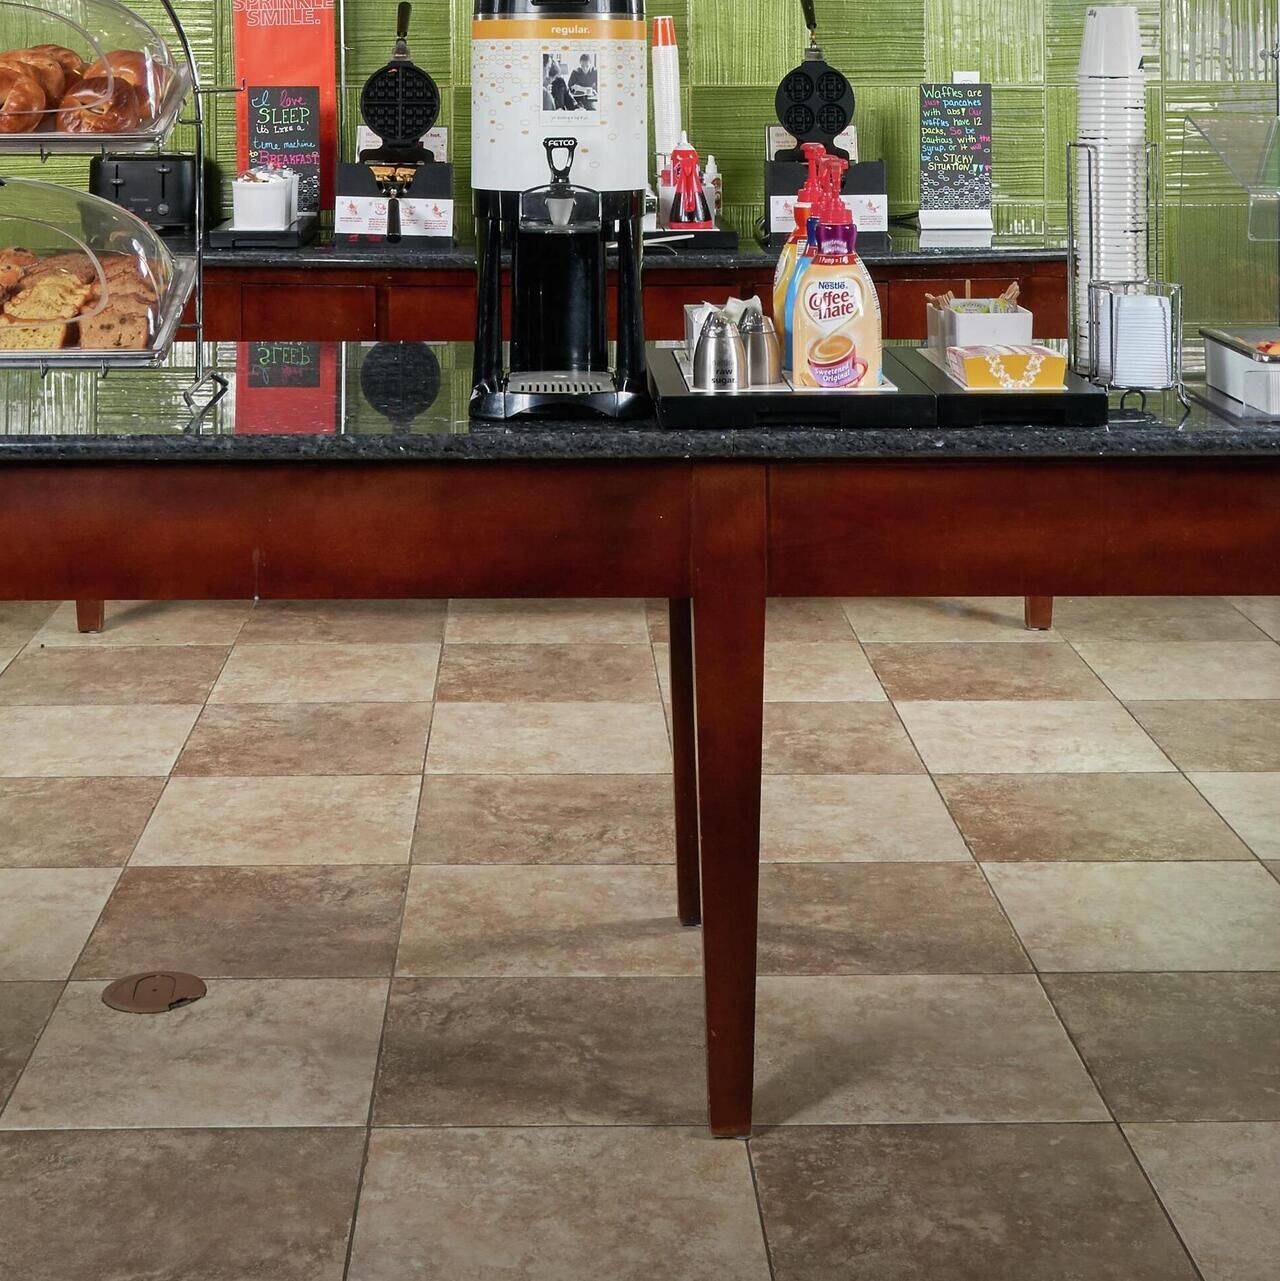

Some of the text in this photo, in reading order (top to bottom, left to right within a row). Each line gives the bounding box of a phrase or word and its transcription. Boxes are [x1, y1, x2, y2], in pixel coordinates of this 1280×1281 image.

[247, 8, 321, 26] SMILE.
[921, 85, 982, 98] Waffles are
[280, 89, 306, 107] love
[943, 99, 981, 108] pancakes
[923, 108, 940, 117] with
[921, 117, 982, 127] waffles have 12
[957, 135, 976, 143] with
[943, 153, 974, 163] STICKY
[815, 363, 850, 376] Sweetened
[822, 369, 850, 384] Original
[712, 378, 735, 386] sugar
